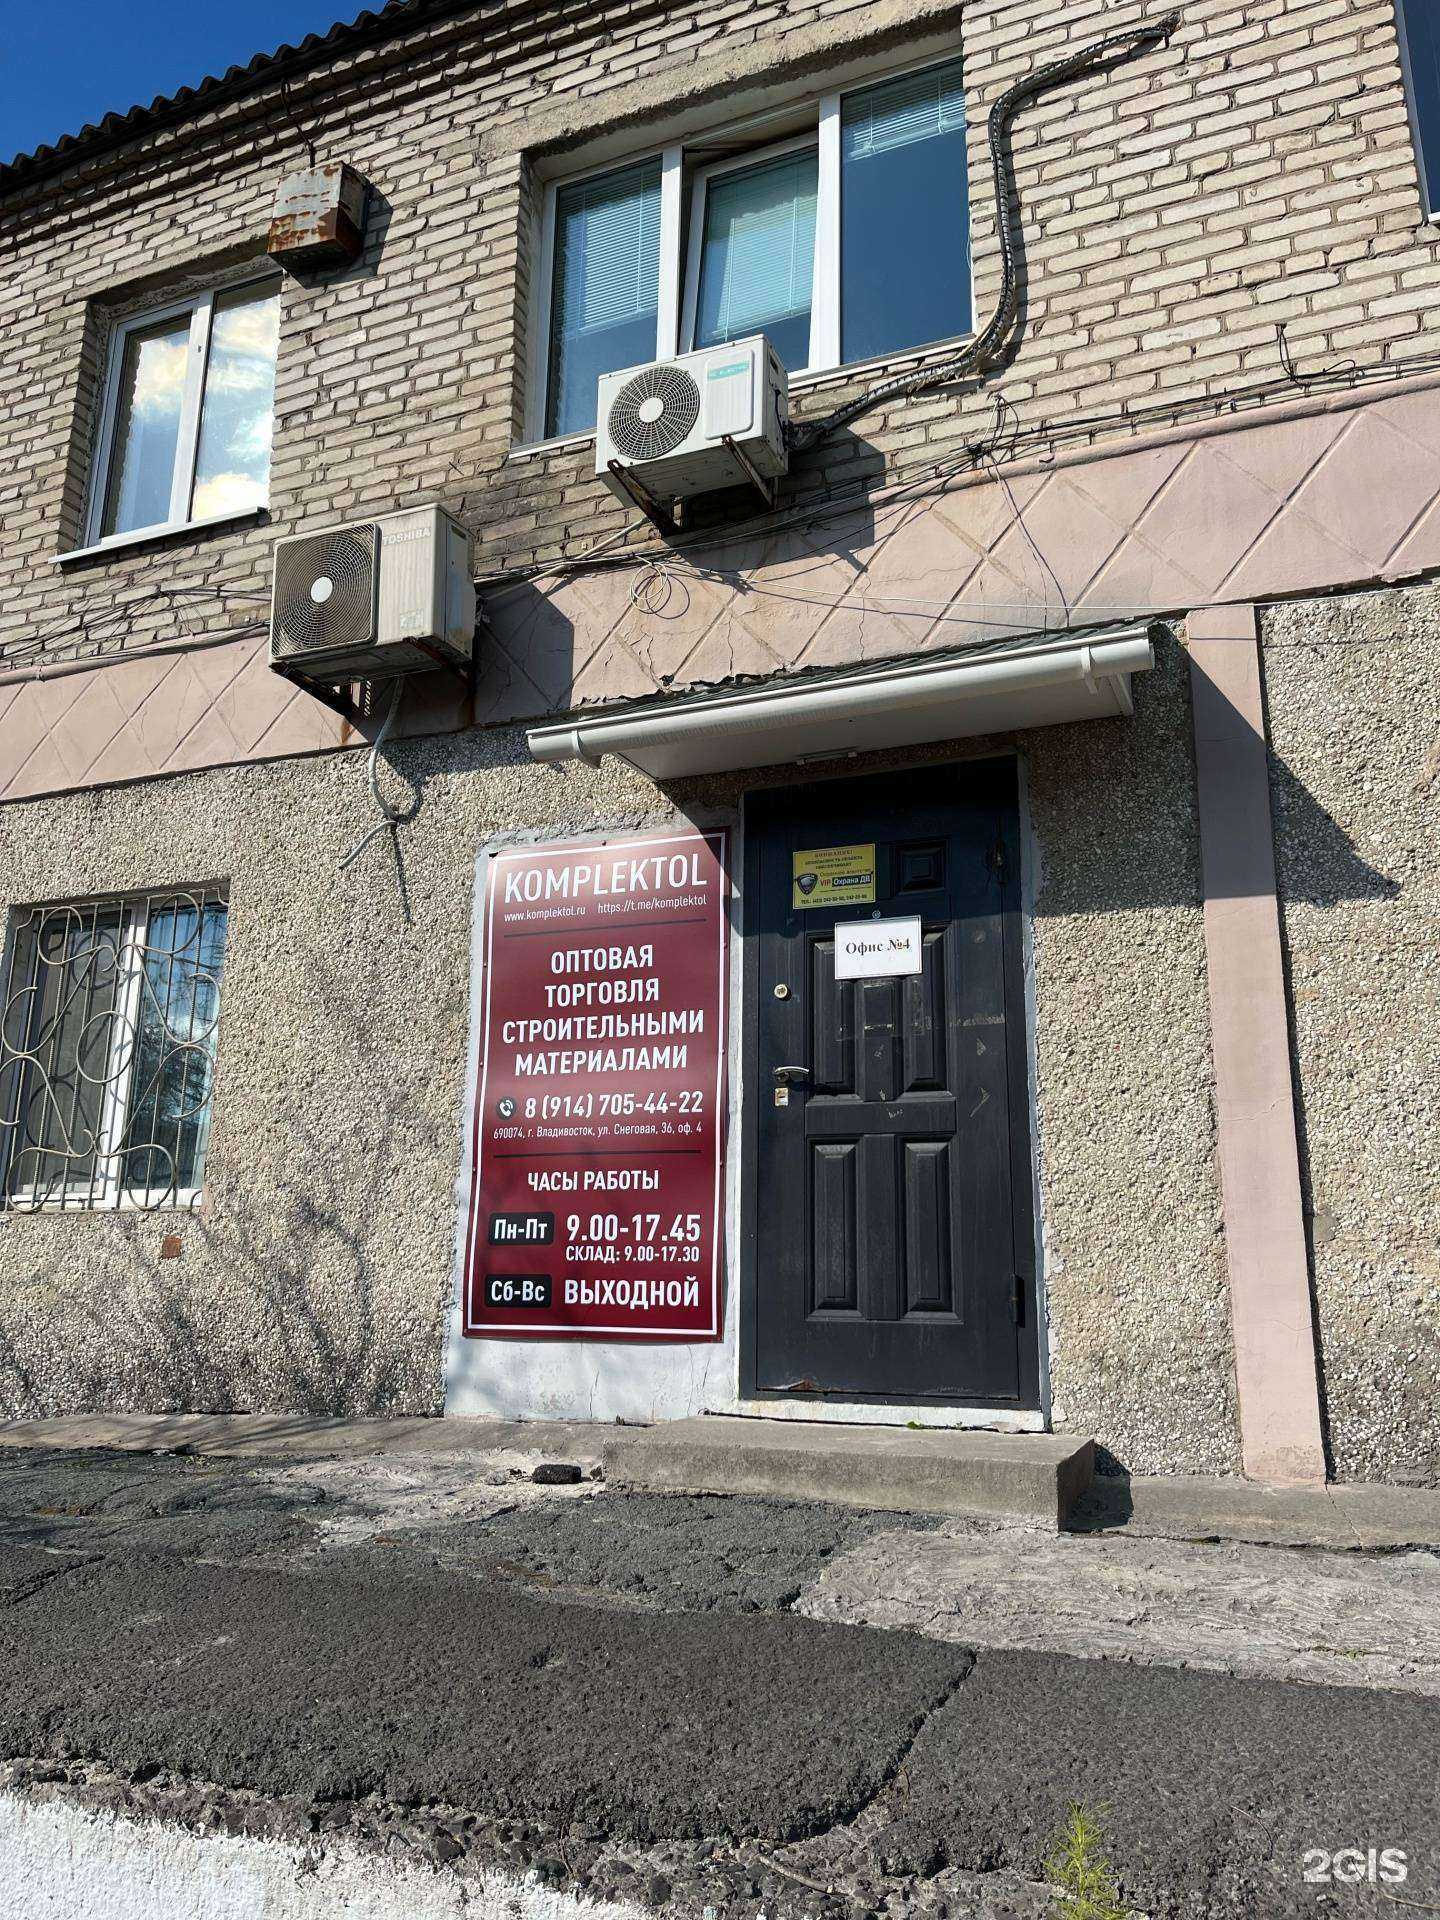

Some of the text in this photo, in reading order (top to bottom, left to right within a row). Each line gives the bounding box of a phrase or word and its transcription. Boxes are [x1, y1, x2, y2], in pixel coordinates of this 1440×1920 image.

[383, 528, 431, 545] TOSHIBA
[504, 853, 708, 904] KOMPLEKTOL
[833, 876, 859, 886] Охрана
[504, 894, 707, 922] www.komplektol.ru https://t.me/komplektol
[551, 944, 653, 974] ОПТОВАЯ
[846, 941, 884, 956] Офис
[544, 978, 659, 1008] ТОРГОВЛЯ
[502, 1009, 704, 1044] СТРОИТЕЛЬНЫМИ
[514, 1045, 687, 1076] МАТЕРИАЛАМИ
[599, 1090, 703, 1116] 705-44-22
[493, 1121, 702, 1140] 690074, г. Владивосток, ул. Снеговая, 36, оф. 4
[527, 1169, 659, 1192] ЧАСЫ РАБОТЫ
[494, 1213, 701, 1242] Пн-Пт 9.00-17.45
[565, 1245, 700, 1264] СКЛАД: 9.00-17.30
[491, 1275, 699, 1310] Сб-Вс ВЫХОДНОЙ
